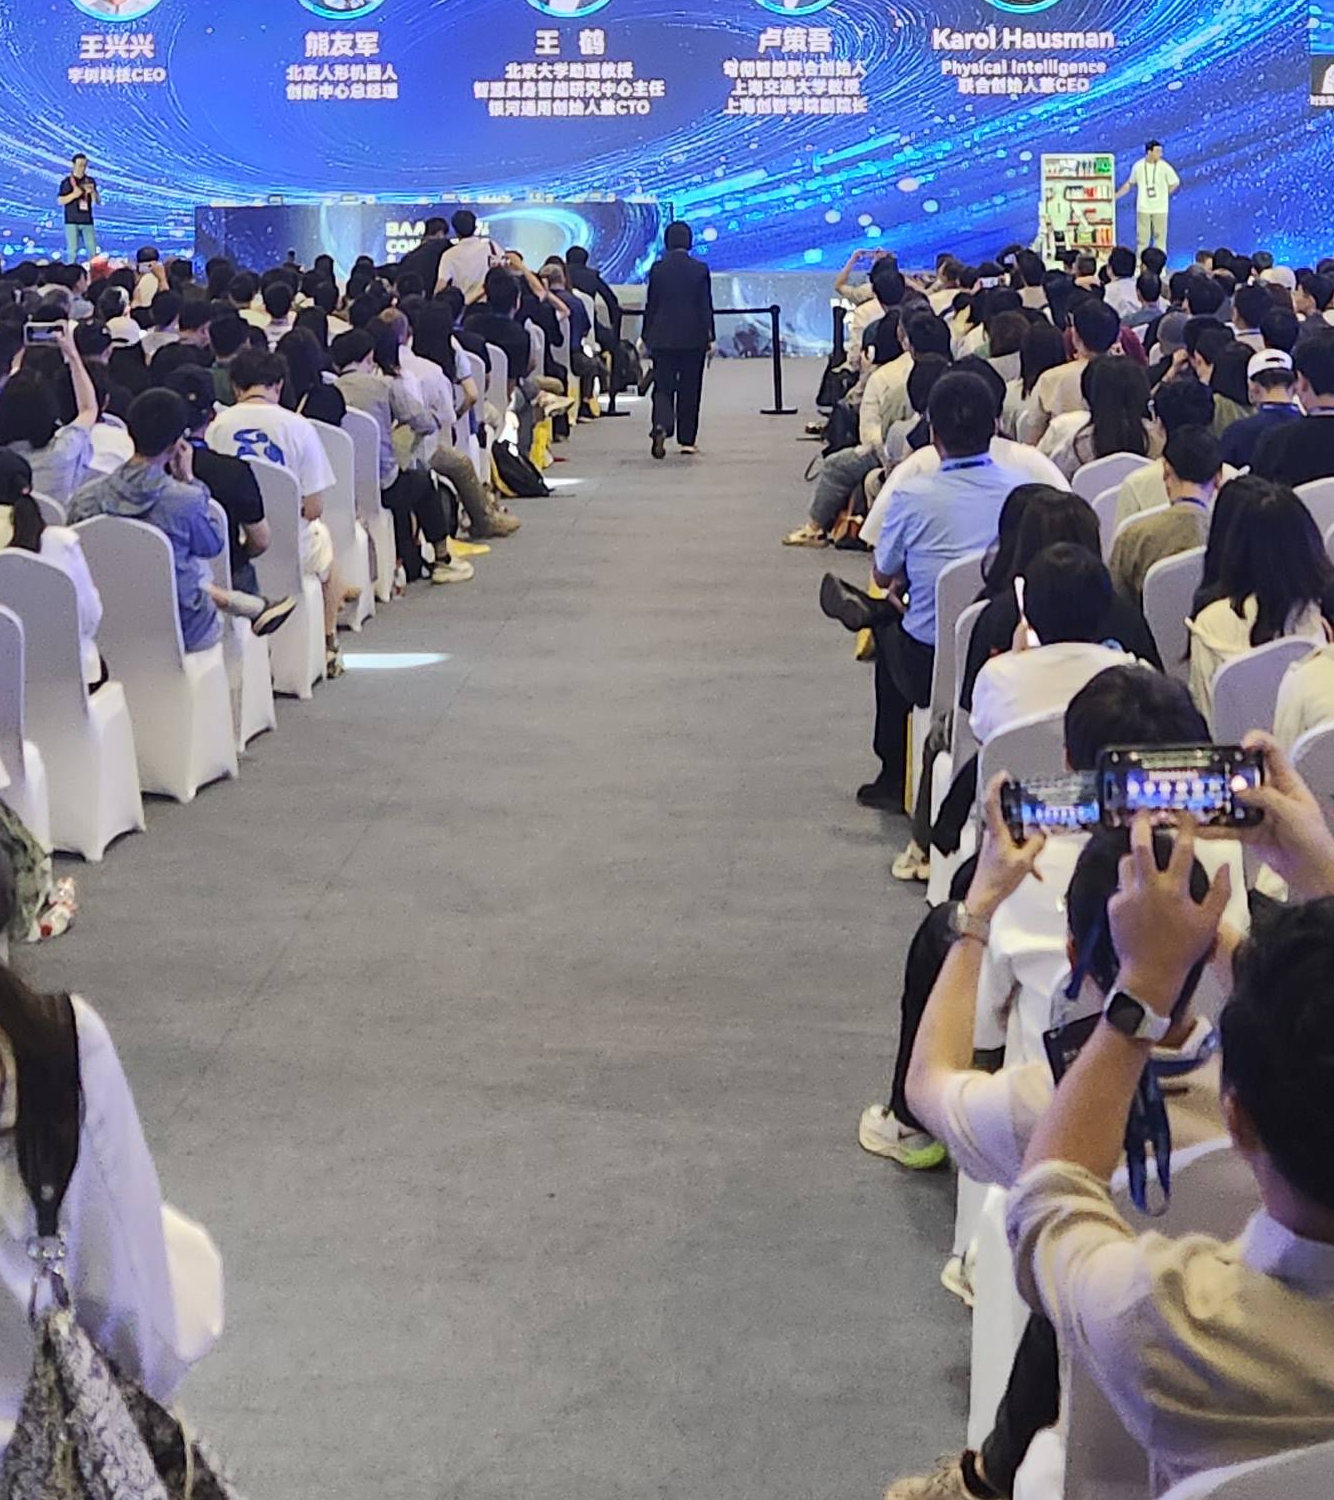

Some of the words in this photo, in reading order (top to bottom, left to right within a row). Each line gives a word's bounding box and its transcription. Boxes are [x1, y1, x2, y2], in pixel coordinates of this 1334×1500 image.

[79, 32, 155, 59] 王兴兴
[304, 30, 380, 57] 熊友军
[534, 30, 560, 55] 王
[758, 28, 833, 54] 卢策吾
[932, 27, 997, 50] Karol
[1003, 27, 1115, 50] Hausman
[286, 63, 399, 82] 北京人形机器人
[941, 59, 1007, 77] Physical
[1012, 59, 1108, 77] Intelligence
